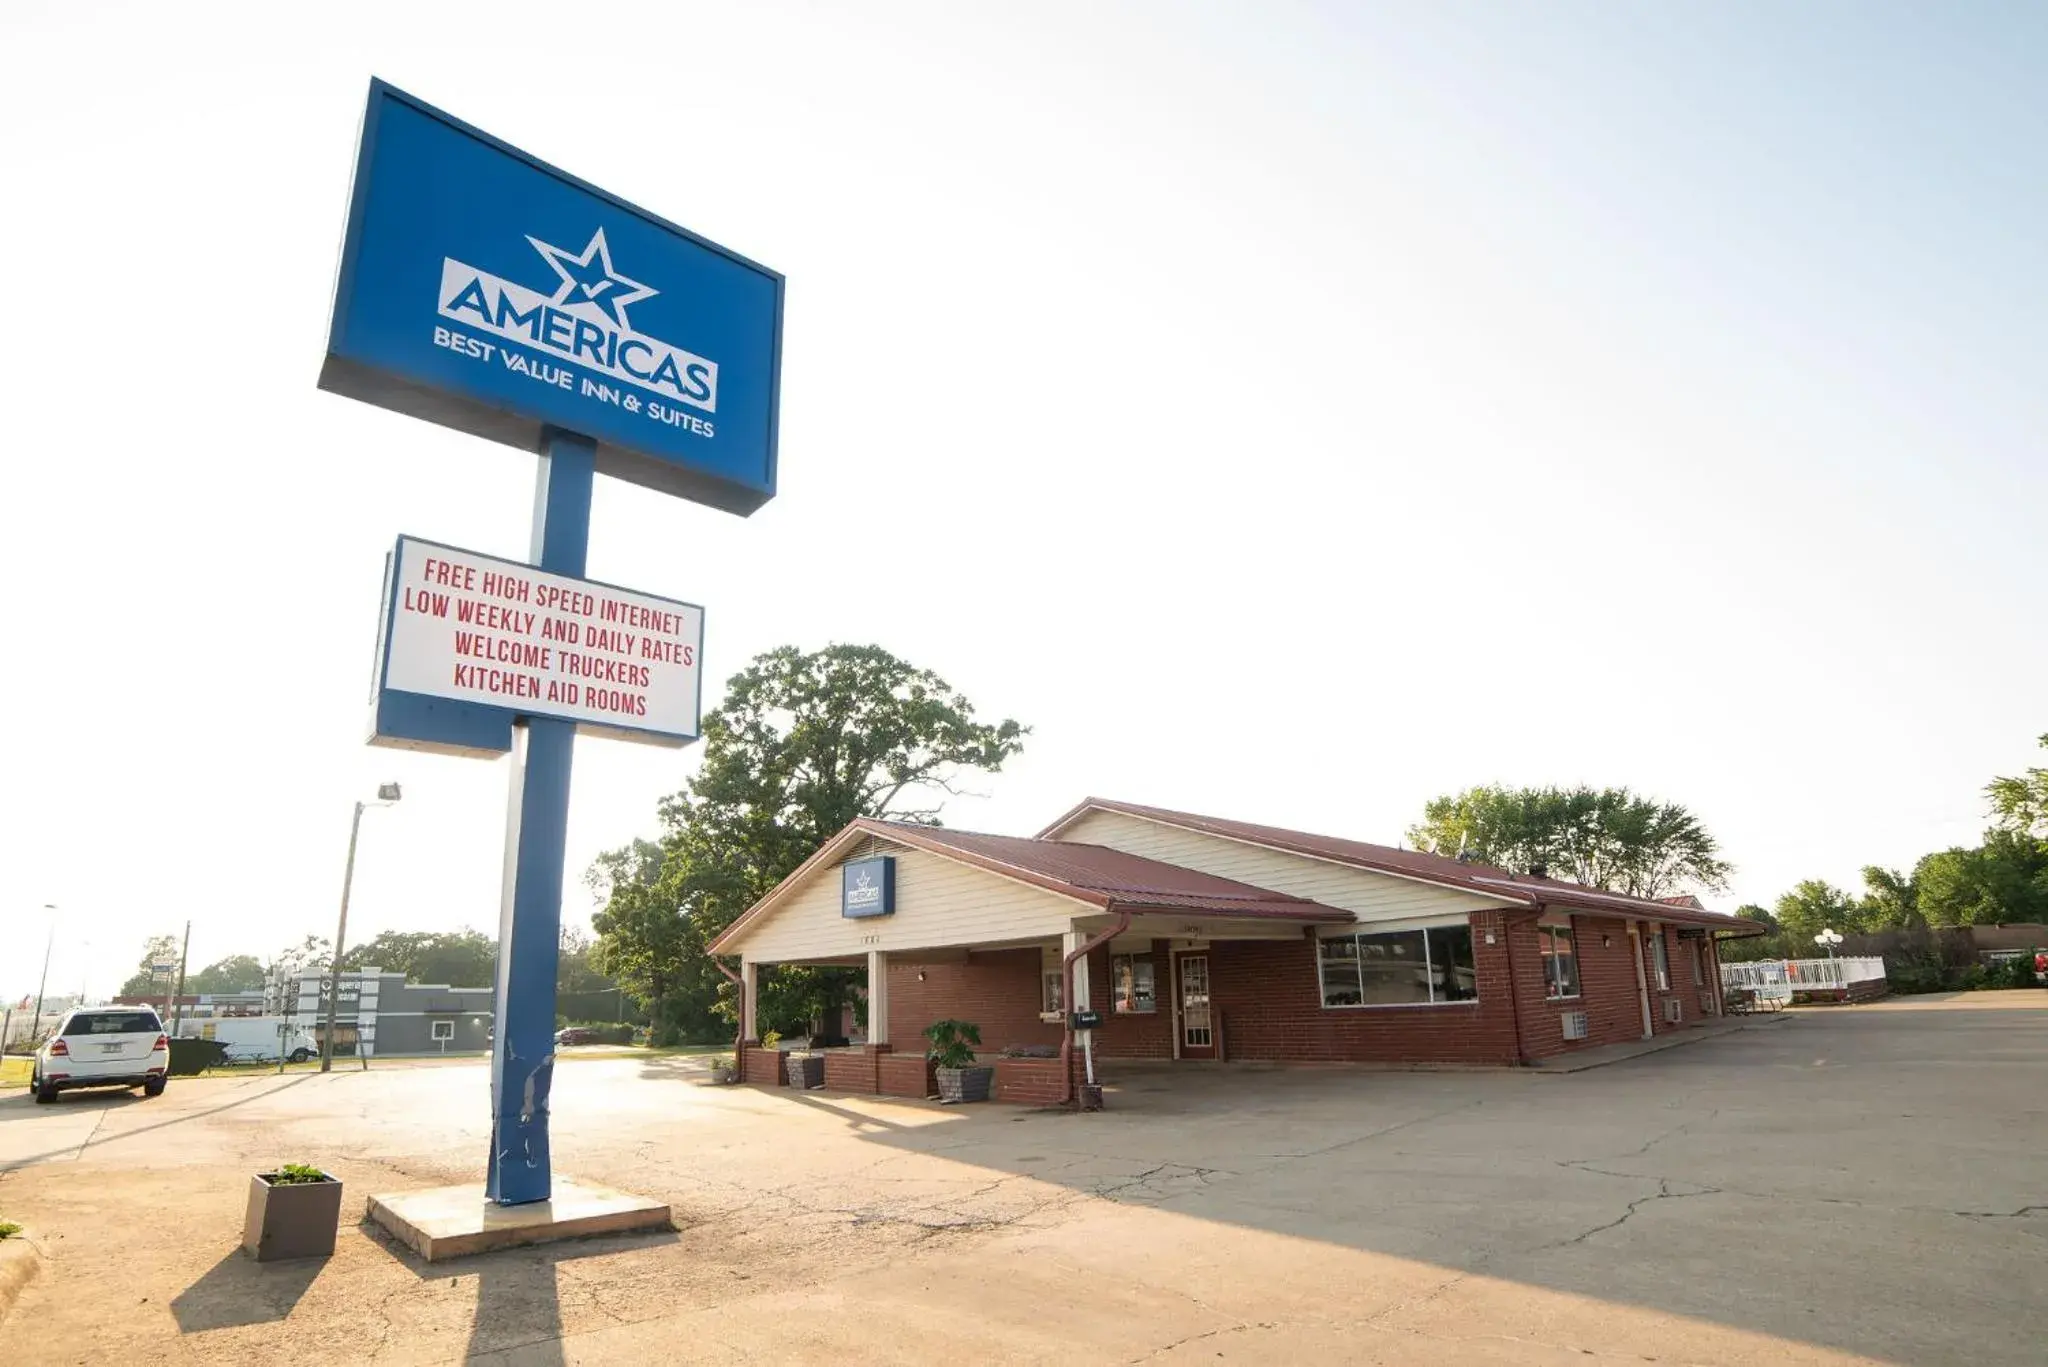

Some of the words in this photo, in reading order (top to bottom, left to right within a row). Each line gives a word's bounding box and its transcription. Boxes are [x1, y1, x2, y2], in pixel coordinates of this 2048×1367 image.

[446, 276, 711, 402] AMERICAS
[433, 326, 496, 362] BEST
[500, 349, 573, 390] VALUE
[581, 378, 619, 406] INN
[623, 394, 642, 413] &
[647, 402, 714, 438] SUITES
[404, 587, 450, 618] LOW
[457, 599, 536, 635] WEEKLY
[541, 617, 579, 644] AND
[586, 626, 636, 655] DAILY
[641, 637, 693, 667] RATES
[424, 558, 476, 591] FREE
[482, 571, 529, 602] HIGH
[536, 584, 594, 616] SPEED
[600, 599, 683, 636] INTERNET
[454, 664, 540, 699] KITCHEN
[547, 680, 579, 705] AID
[585, 687, 646, 717] ROOMS
[455, 631, 550, 670] WELCOME
[558, 651, 650, 688] TRUCKERS
